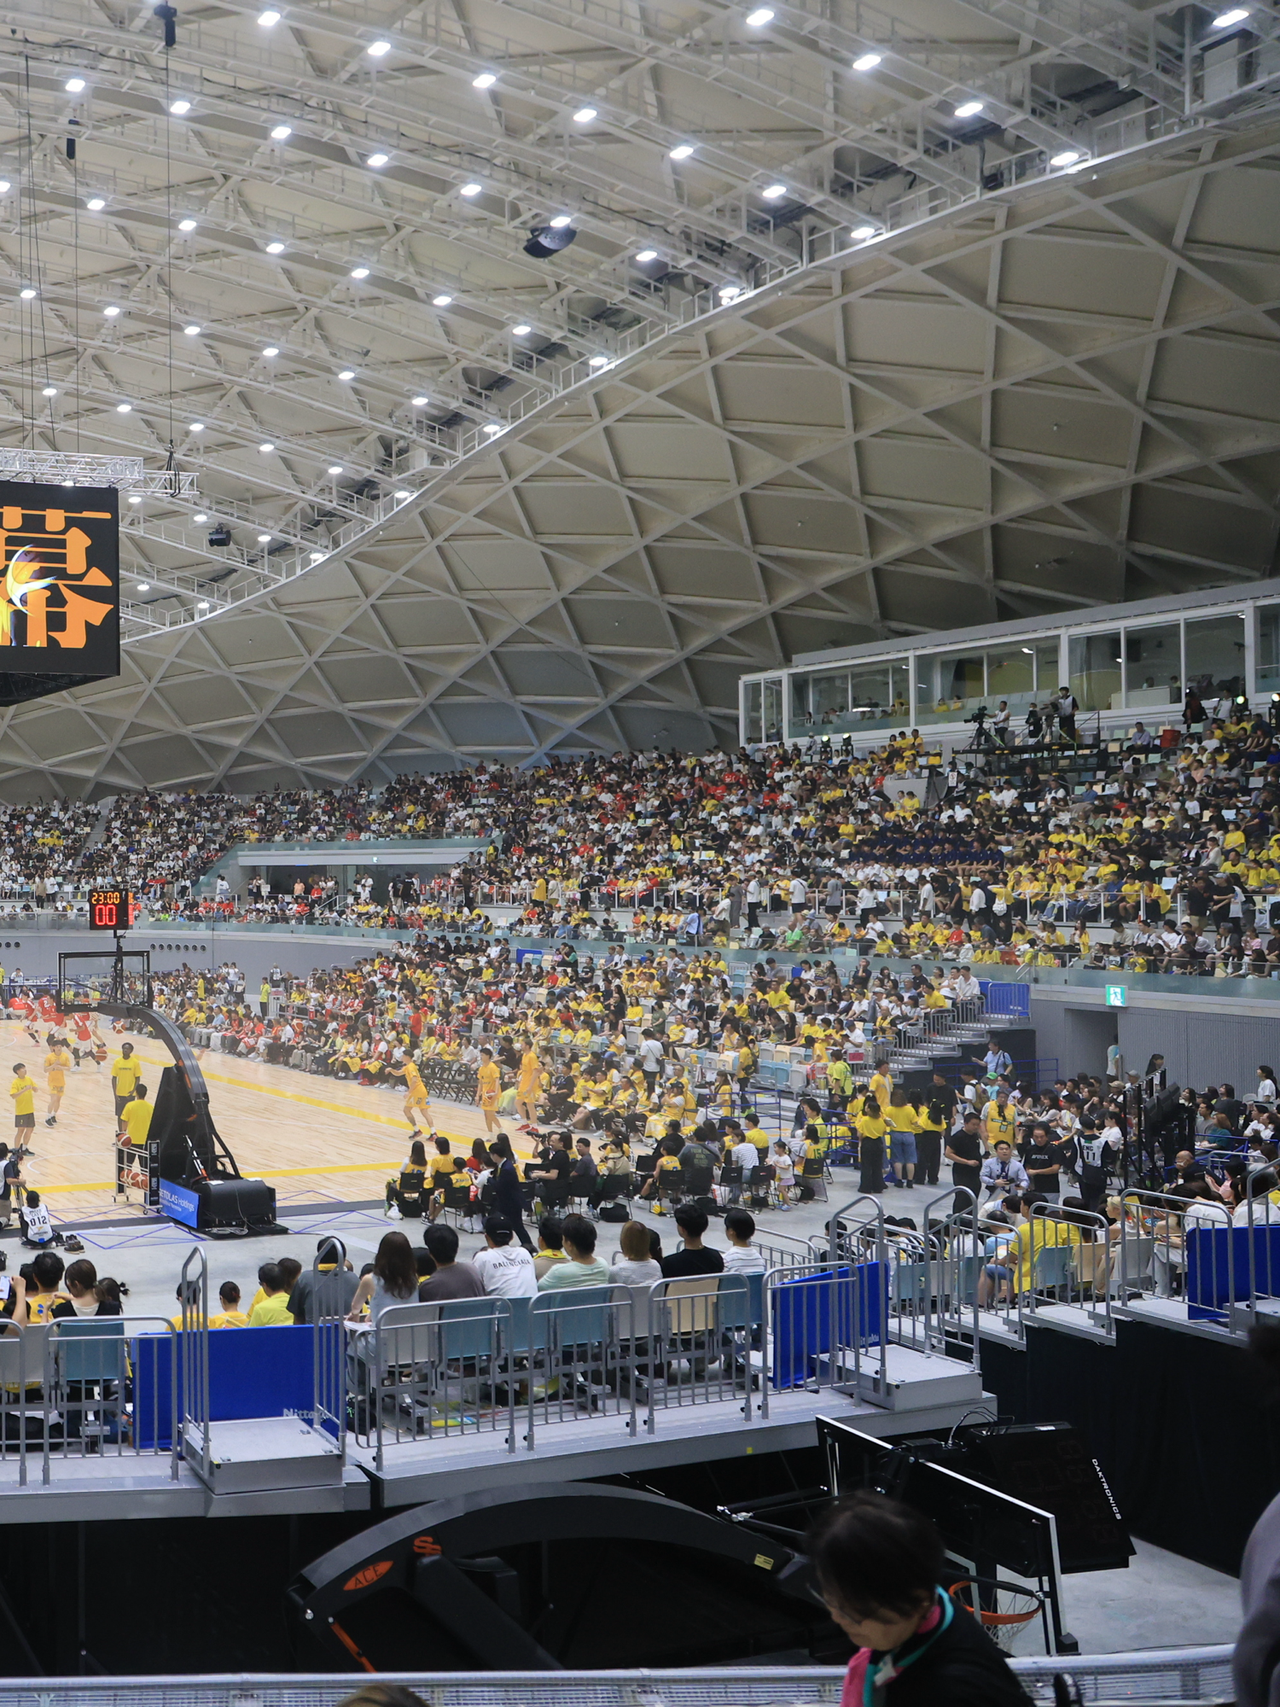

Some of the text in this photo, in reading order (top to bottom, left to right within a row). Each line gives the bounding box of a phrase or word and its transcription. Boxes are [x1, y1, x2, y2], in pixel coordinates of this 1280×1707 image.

[91, 892, 120, 904] 23:00
[95, 904, 117, 925] 00
[29, 1215, 48, 1227] 012
[1091, 1458, 1122, 1520] DAKTRONICS
[353, 1564, 384, 1588] ACE
